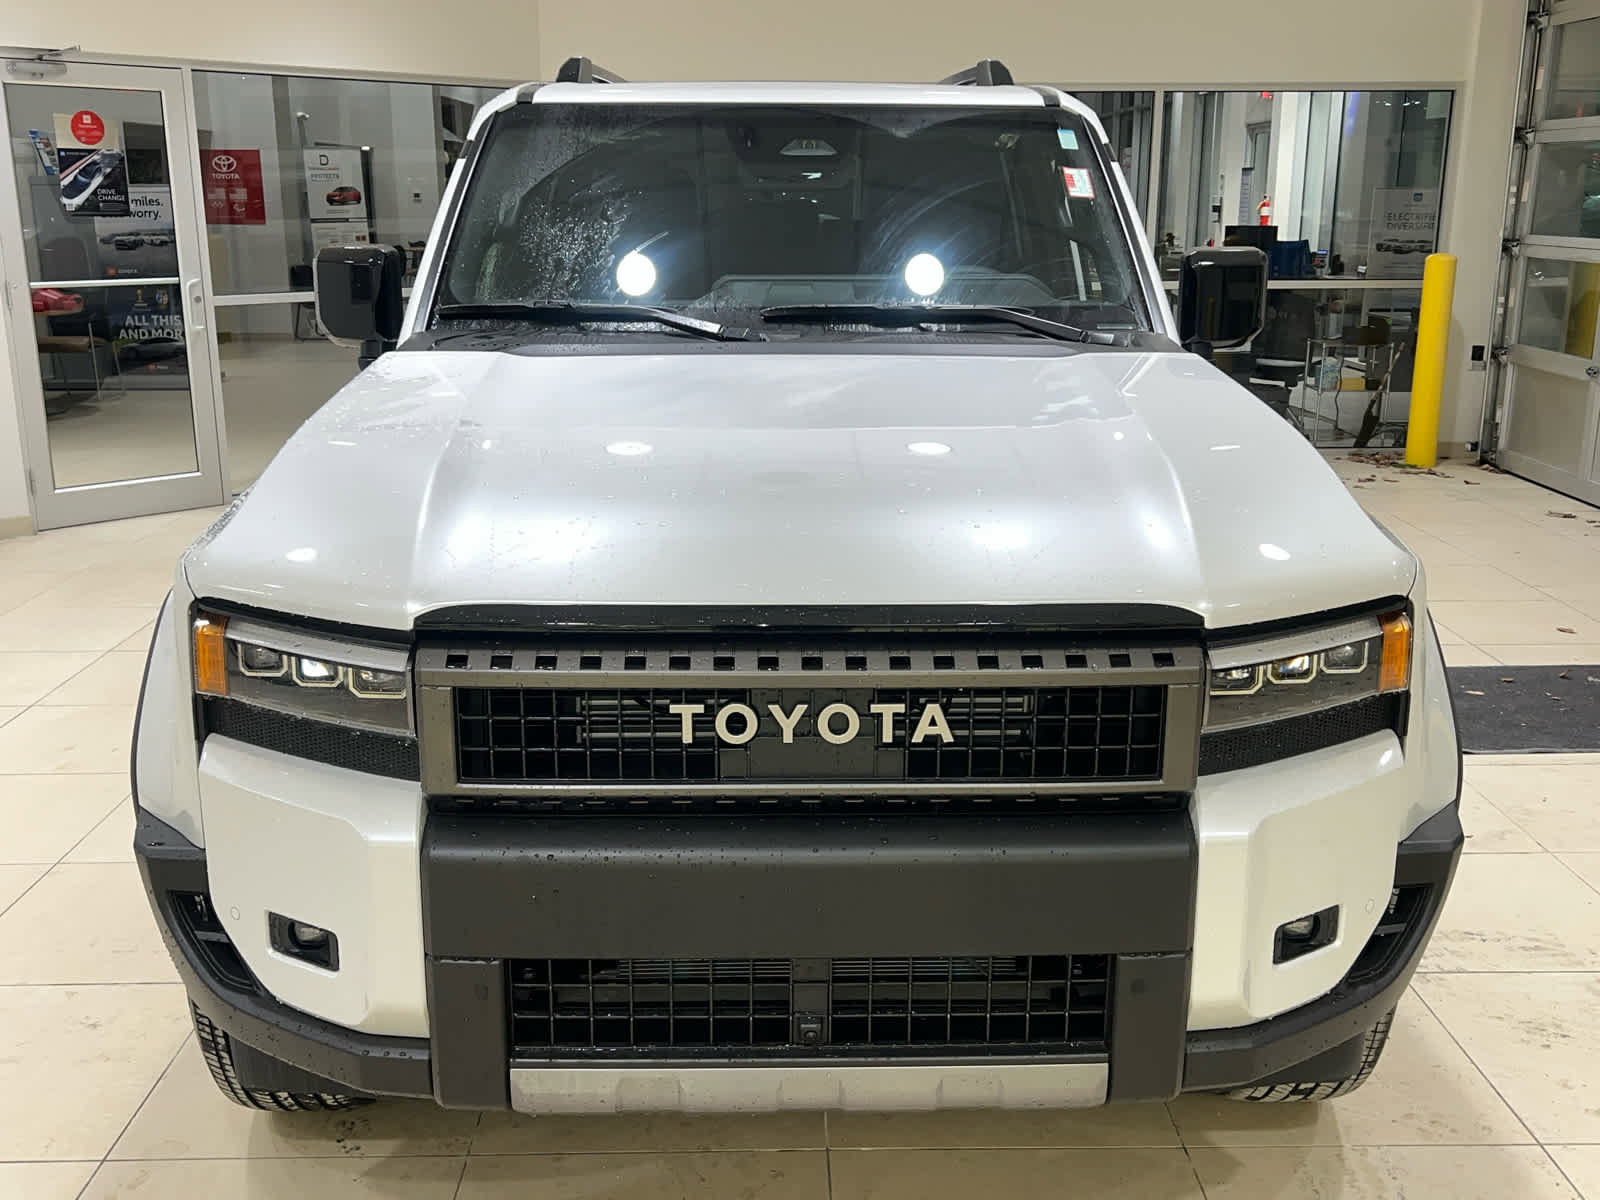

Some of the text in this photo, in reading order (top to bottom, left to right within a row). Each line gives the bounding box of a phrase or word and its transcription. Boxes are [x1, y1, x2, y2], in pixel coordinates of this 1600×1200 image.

[130, 195, 164, 207] miles.
[125, 314, 182, 328] ALL THIS
[119, 328, 184, 341] AND MOR
[669, 703, 954, 745] TOYOTA
